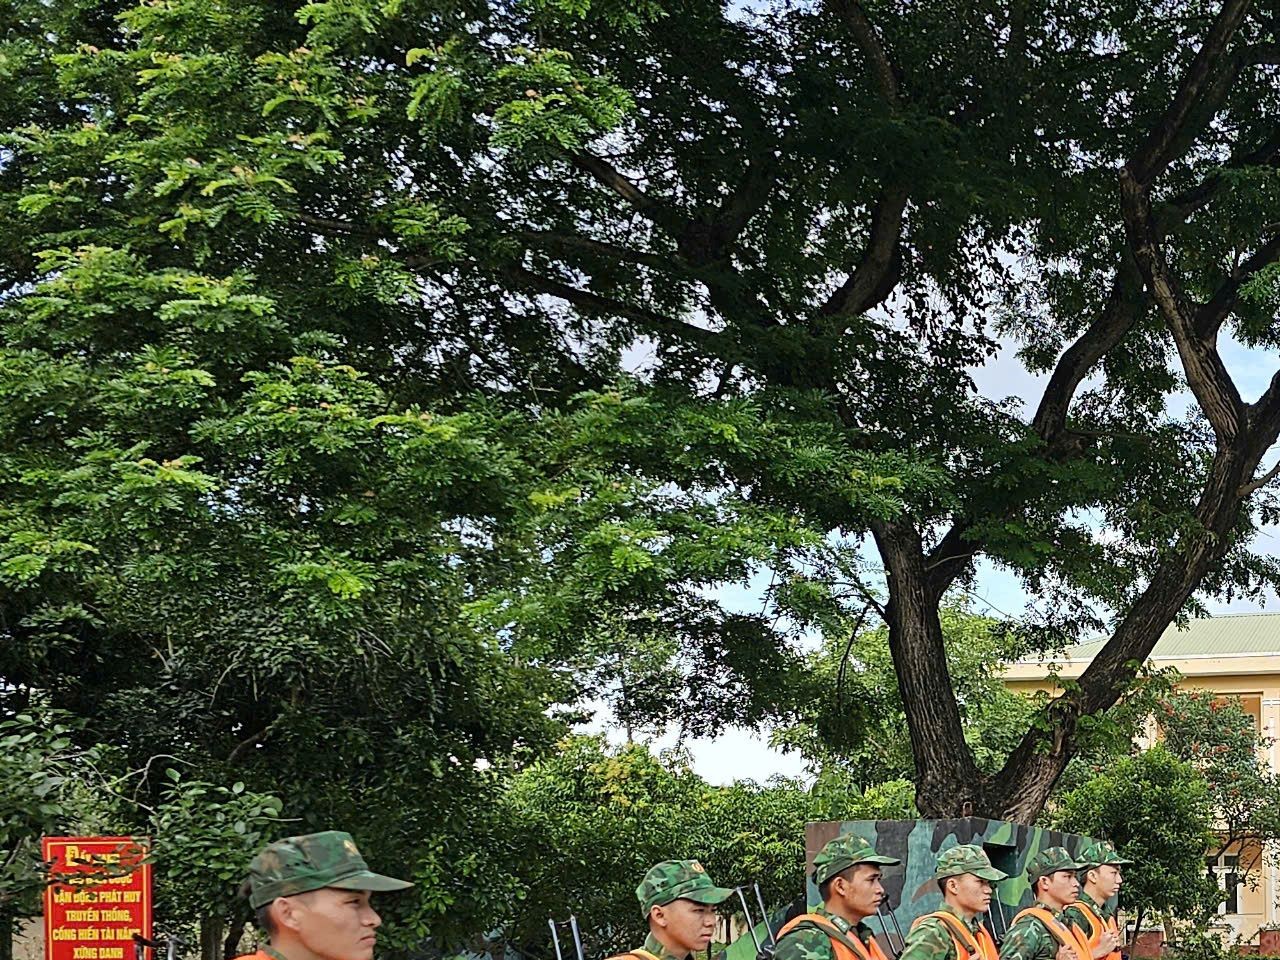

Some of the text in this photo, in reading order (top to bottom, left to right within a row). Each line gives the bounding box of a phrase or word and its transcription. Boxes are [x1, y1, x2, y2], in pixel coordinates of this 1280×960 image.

[53, 889, 72, 905] VẬN
[99, 888, 122, 903] PHÁT
[123, 891, 141, 903] HUY
[101, 906, 133, 922] THỐNG,
[52, 925, 77, 940] CỐNG
[78, 925, 99, 940] HIẾN
[101, 926, 115, 940] TÀI
[73, 945, 123, 959] XỨNG DANH
